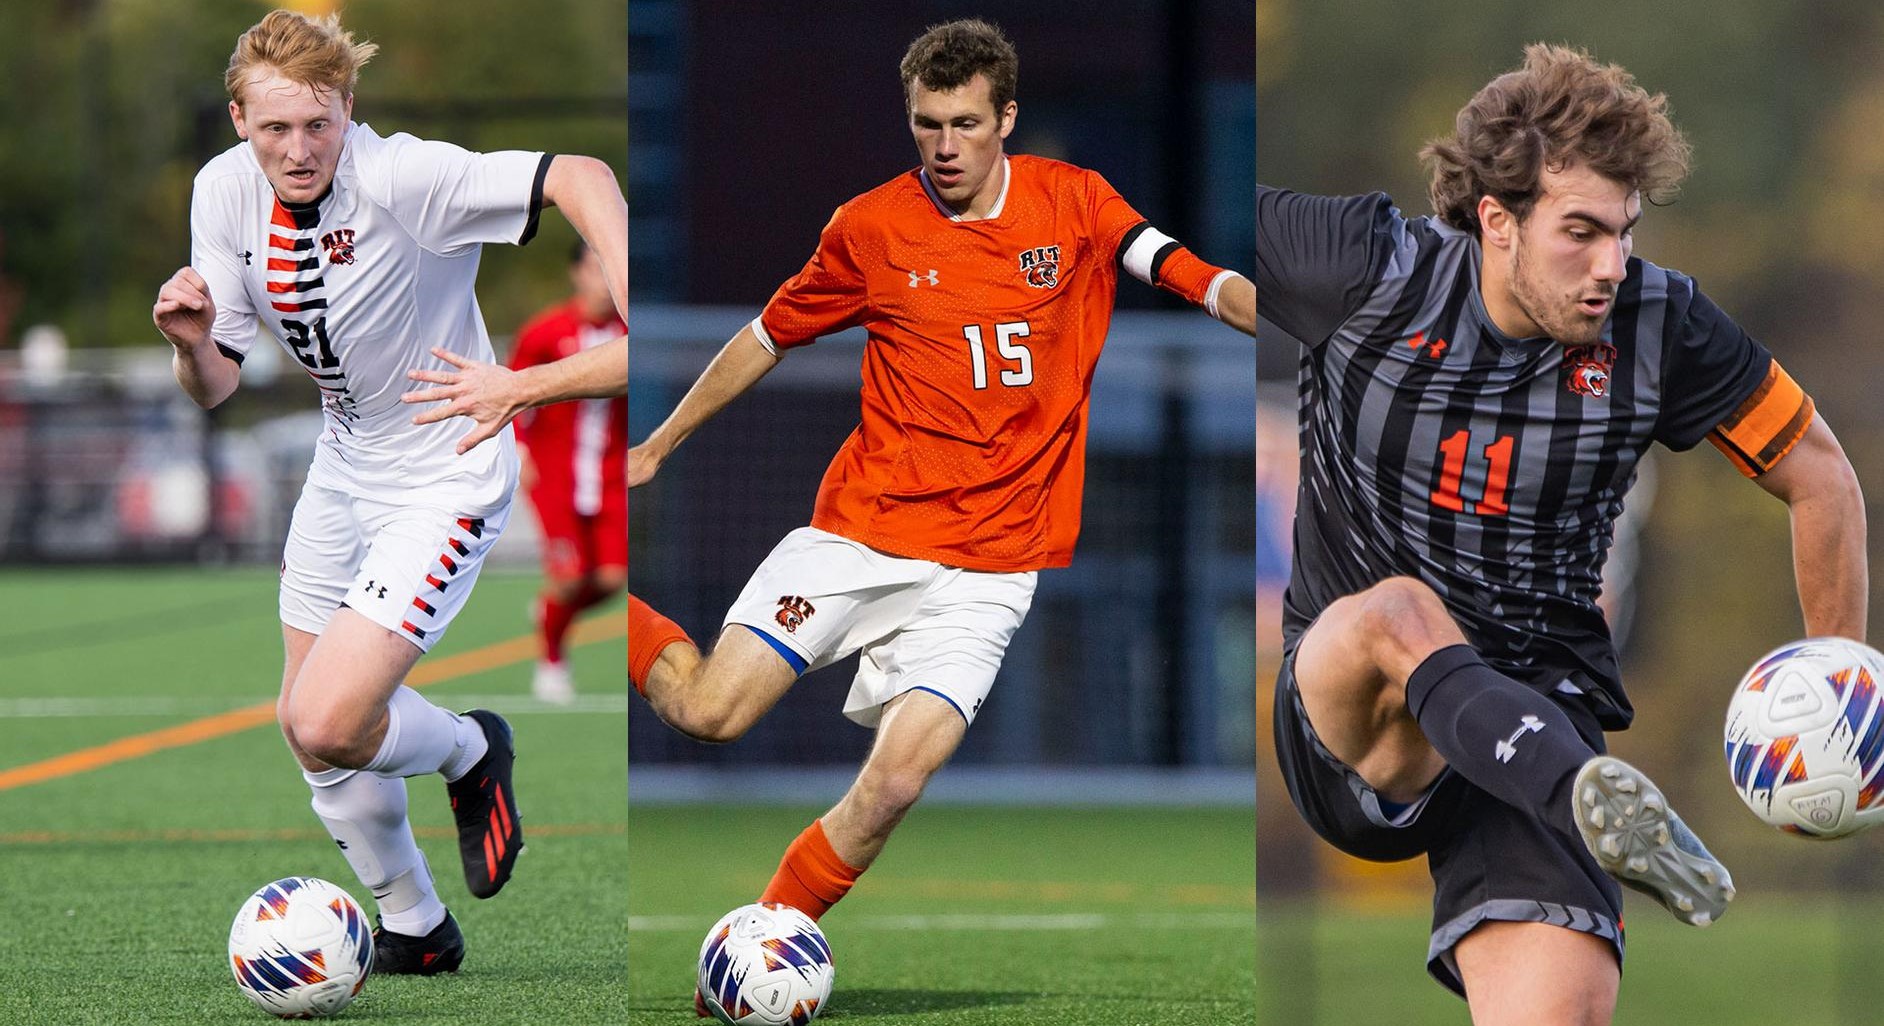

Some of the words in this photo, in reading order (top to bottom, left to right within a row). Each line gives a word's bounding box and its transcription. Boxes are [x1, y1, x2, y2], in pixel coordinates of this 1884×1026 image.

[320, 228, 356, 252] RIT
[1019, 244, 1061, 271] RIT
[280, 316, 340, 368] 21
[962, 320, 1034, 390] 15
[1430, 429, 1514, 516] 11
